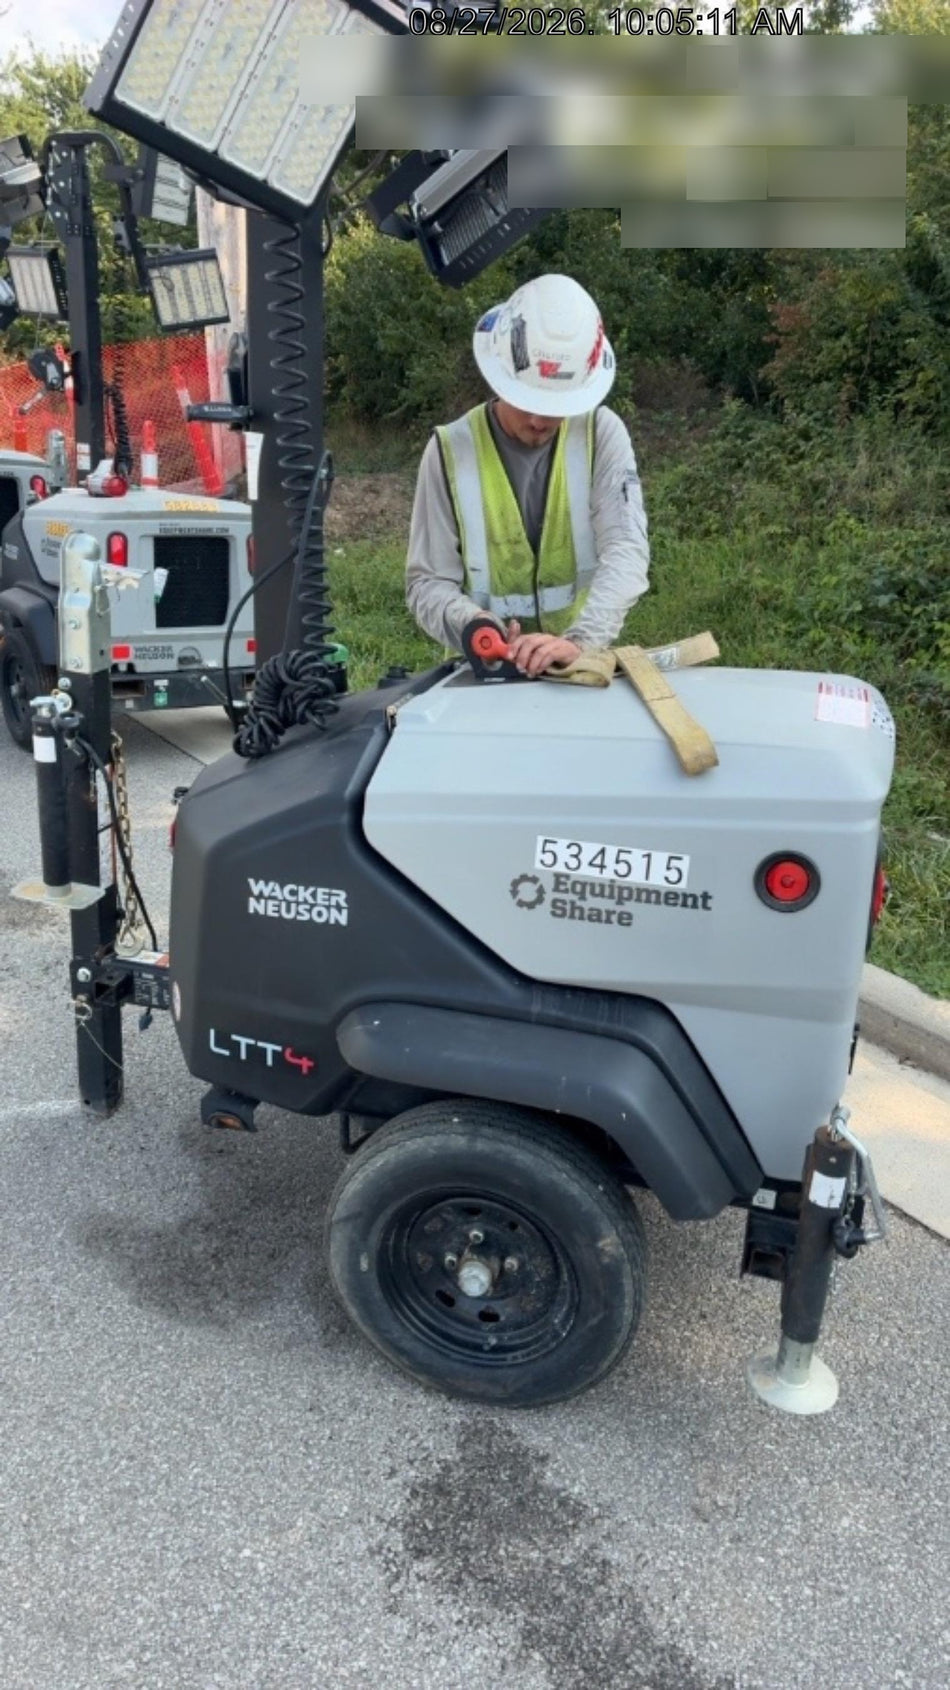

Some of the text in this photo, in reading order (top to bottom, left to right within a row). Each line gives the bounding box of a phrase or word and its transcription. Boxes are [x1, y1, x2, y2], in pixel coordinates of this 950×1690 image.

[539, 838, 684, 886] 534515
[248, 878, 349, 908] WACKER
[552, 872, 713, 911] Equipment
[248, 896, 349, 927] NEUSON
[550, 897, 634, 928] Share
[209, 1028, 315, 1076] LTT4
